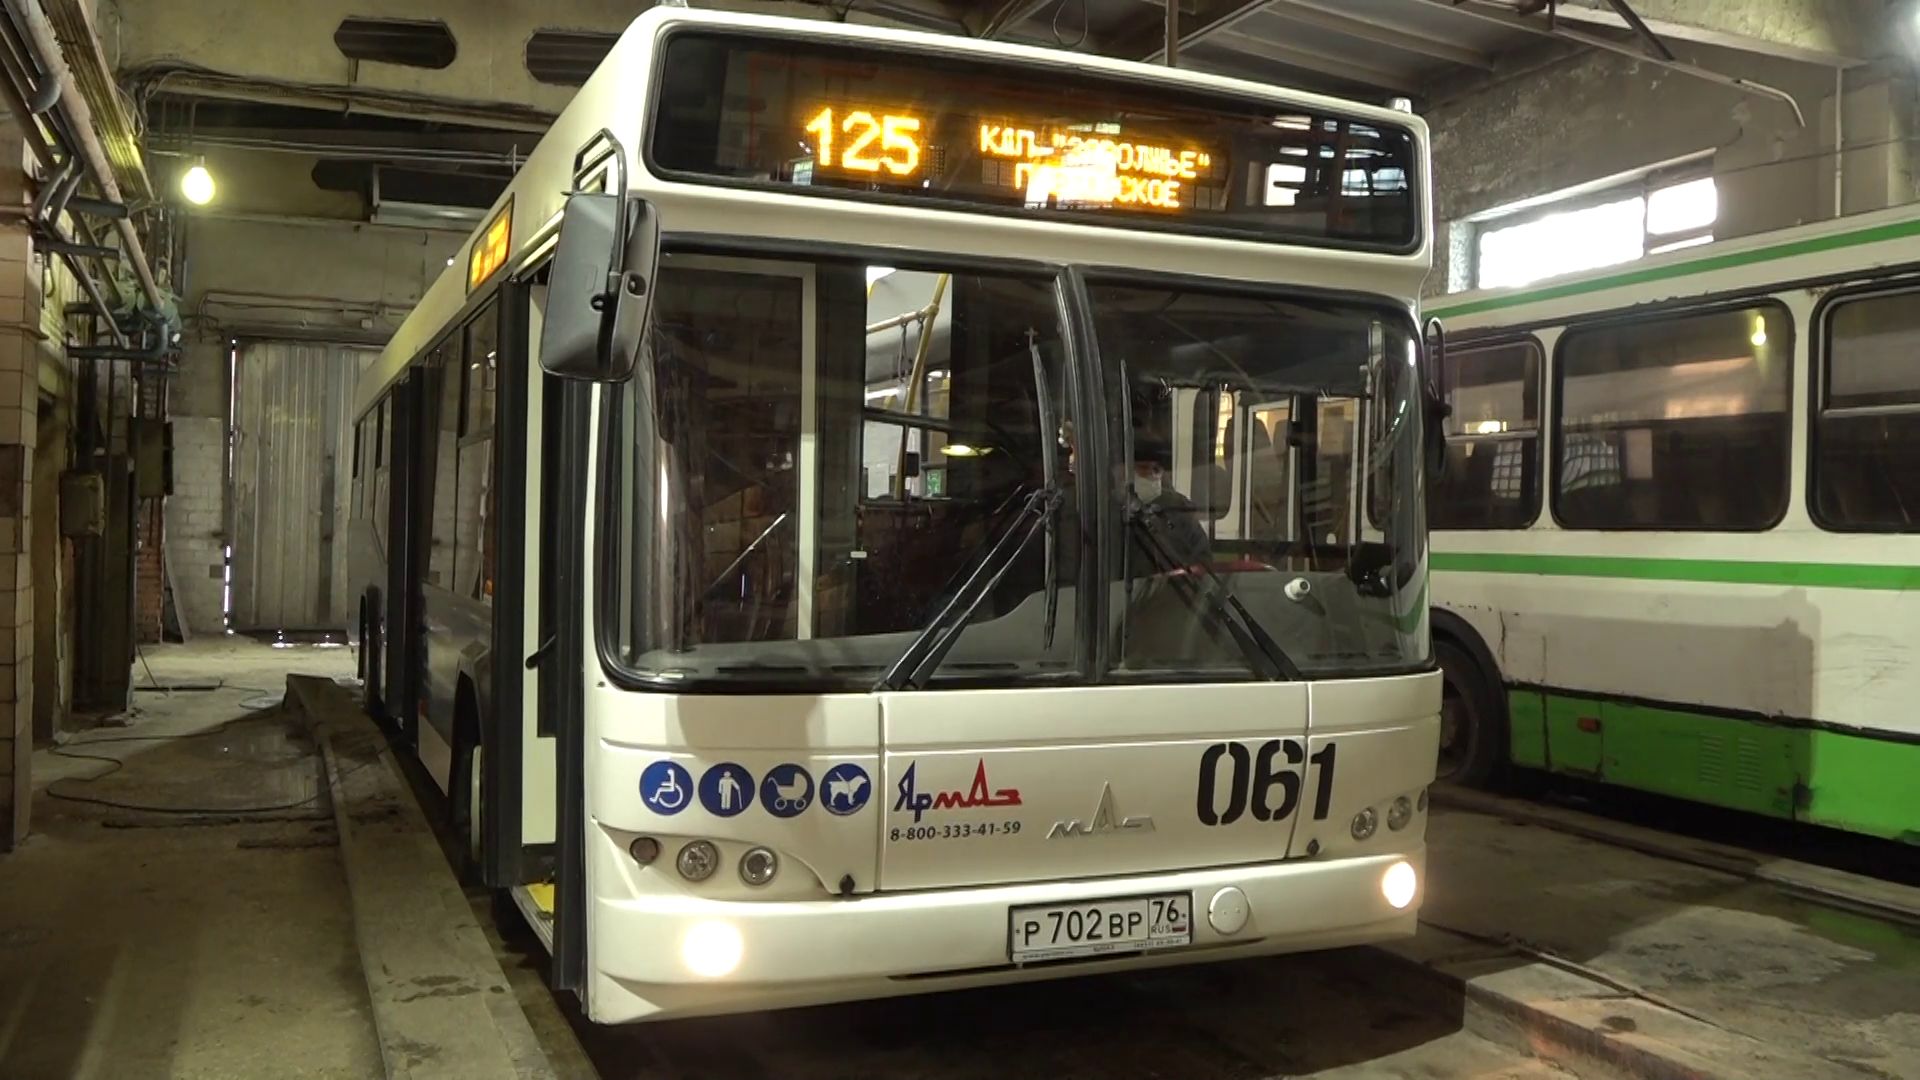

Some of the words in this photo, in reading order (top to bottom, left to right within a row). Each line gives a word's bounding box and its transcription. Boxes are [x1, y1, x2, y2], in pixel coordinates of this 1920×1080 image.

[806, 107, 920, 174] 125
[1197, 739, 1336, 826] 061
[890, 820, 1021, 842] 8-800-333-41-59
[1152, 899, 1179, 924] 76
[1151, 924, 1171, 934] RUS
